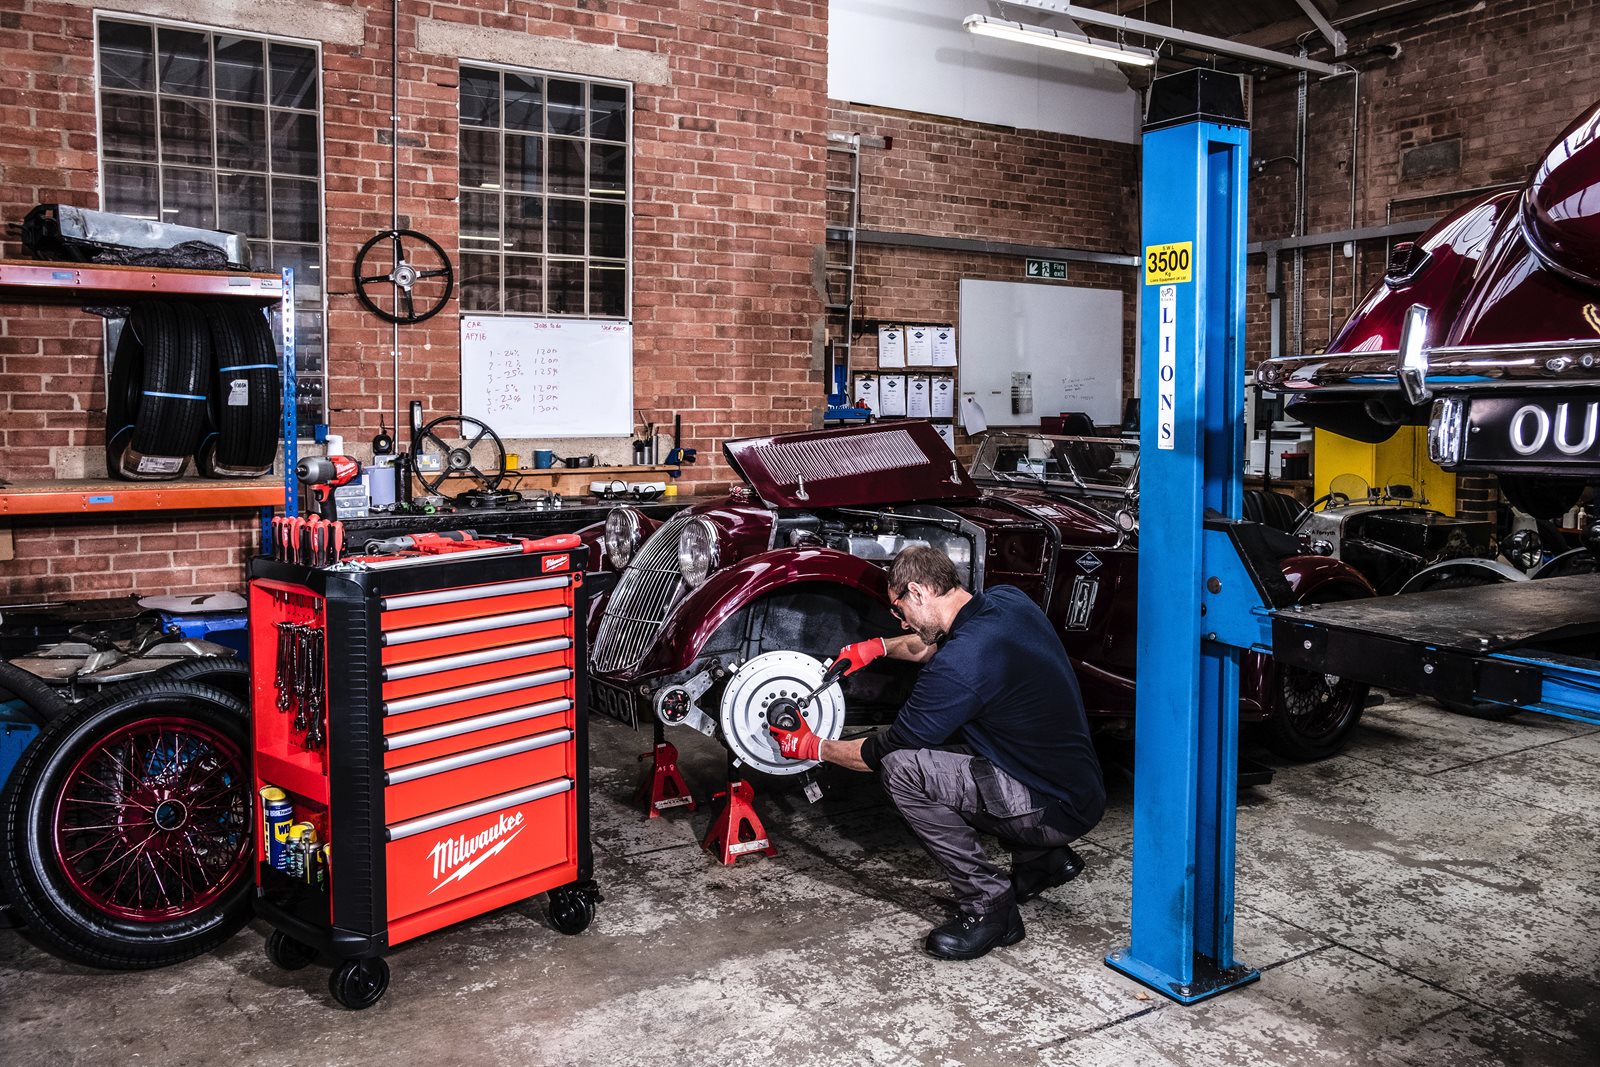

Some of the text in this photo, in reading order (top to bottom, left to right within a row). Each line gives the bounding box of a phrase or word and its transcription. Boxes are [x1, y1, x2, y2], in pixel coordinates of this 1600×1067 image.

[1148, 249, 1189, 273] 3500
[1161, 307, 1173, 440] LIONS
[1509, 402, 1598, 456] OU
[426, 811, 525, 880] Milwaukee
